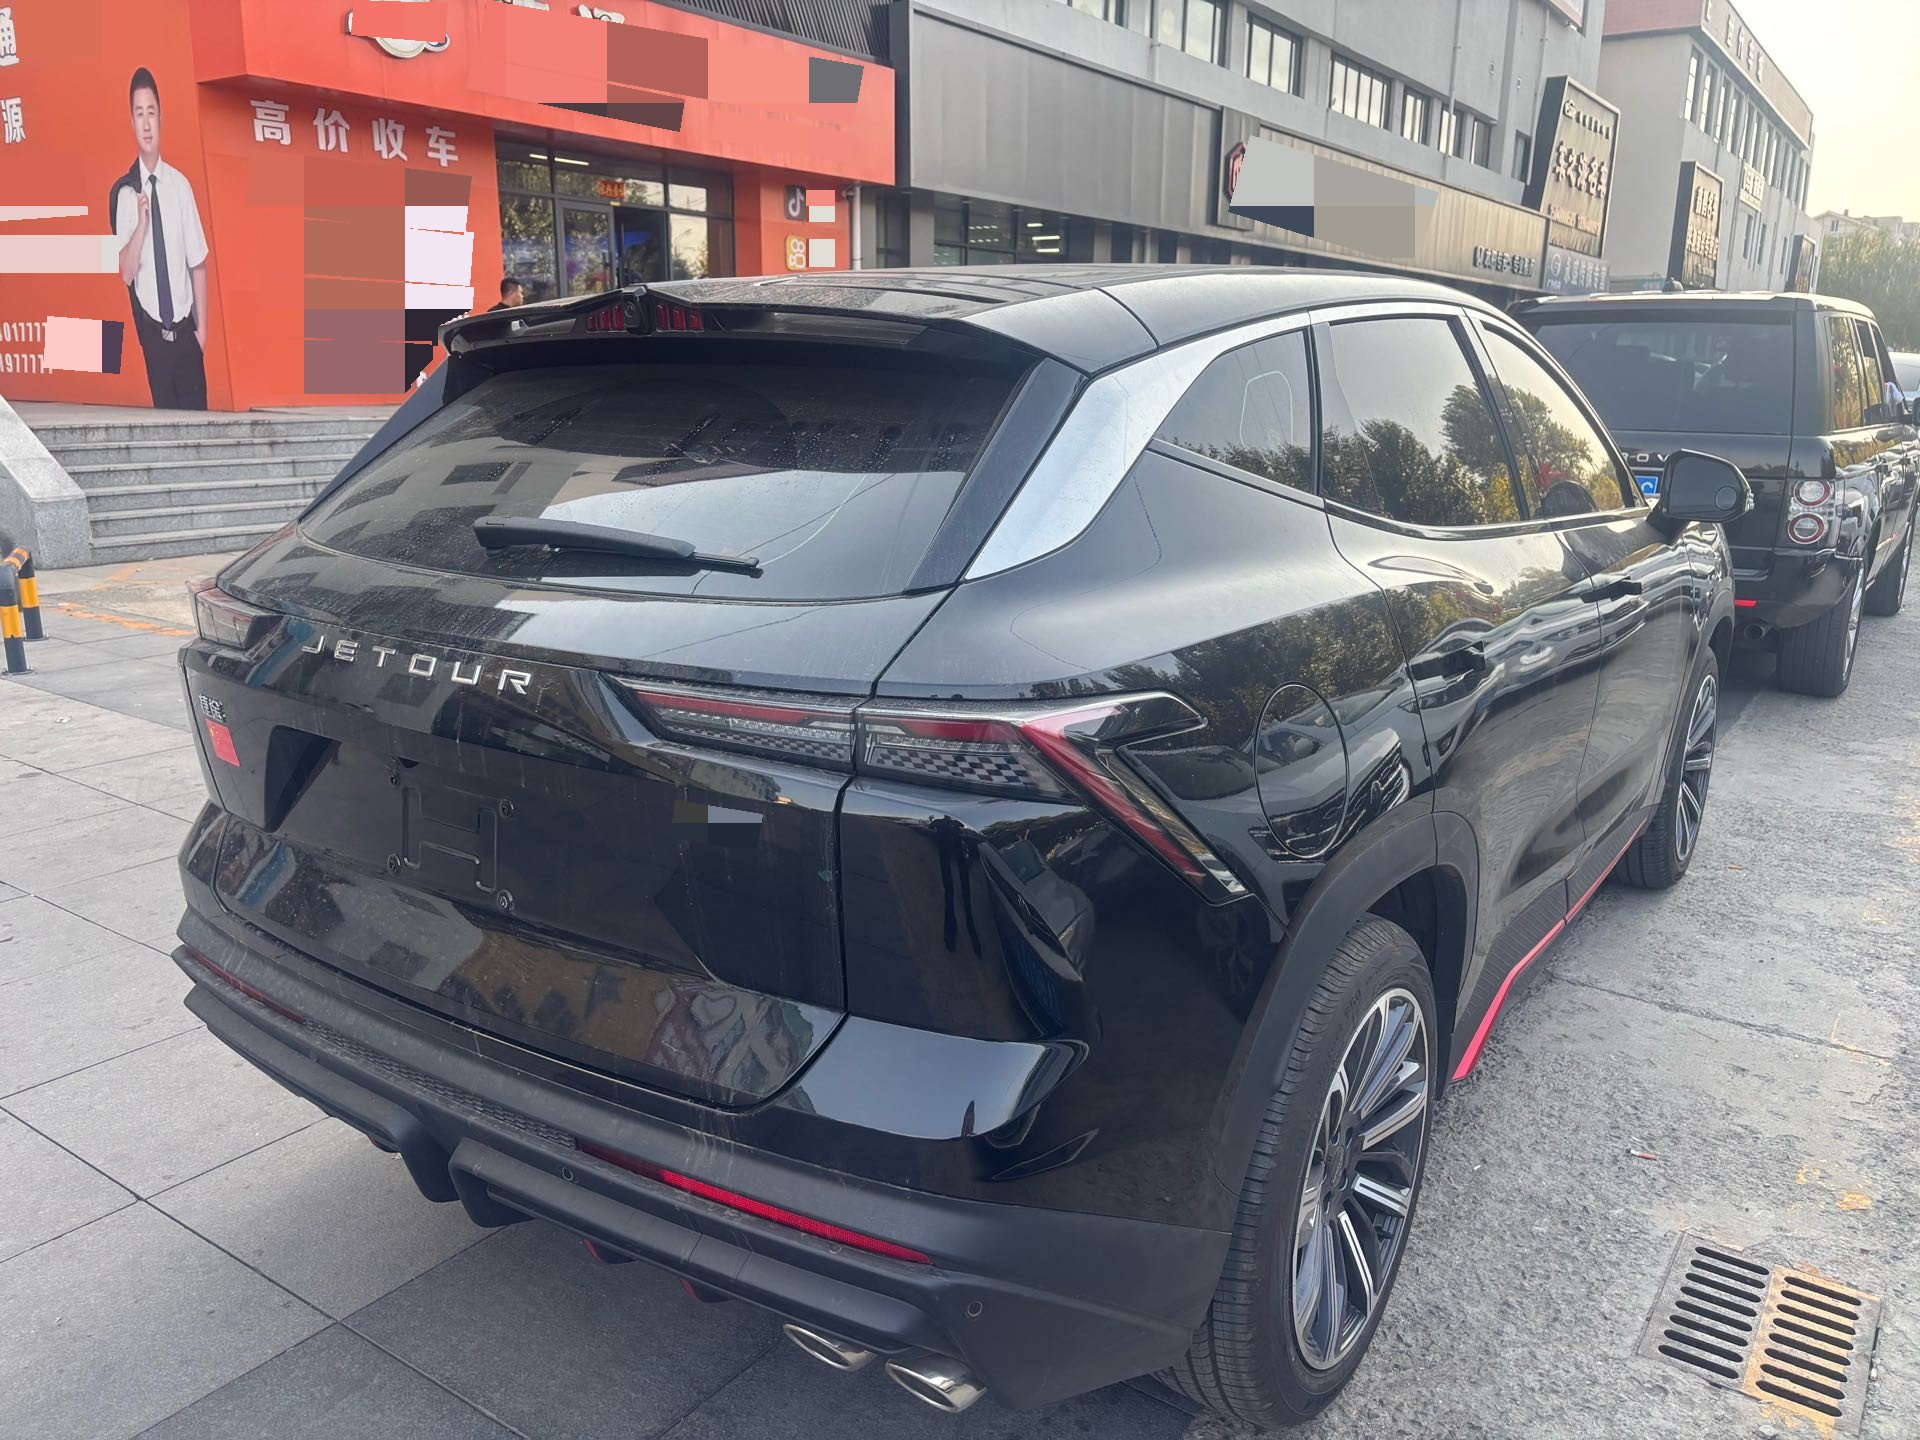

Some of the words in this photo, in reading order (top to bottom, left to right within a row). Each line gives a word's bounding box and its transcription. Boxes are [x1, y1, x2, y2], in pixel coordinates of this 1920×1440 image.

[250, 100, 459, 167] 高价收车
[302, 634, 533, 695] JETOUR
